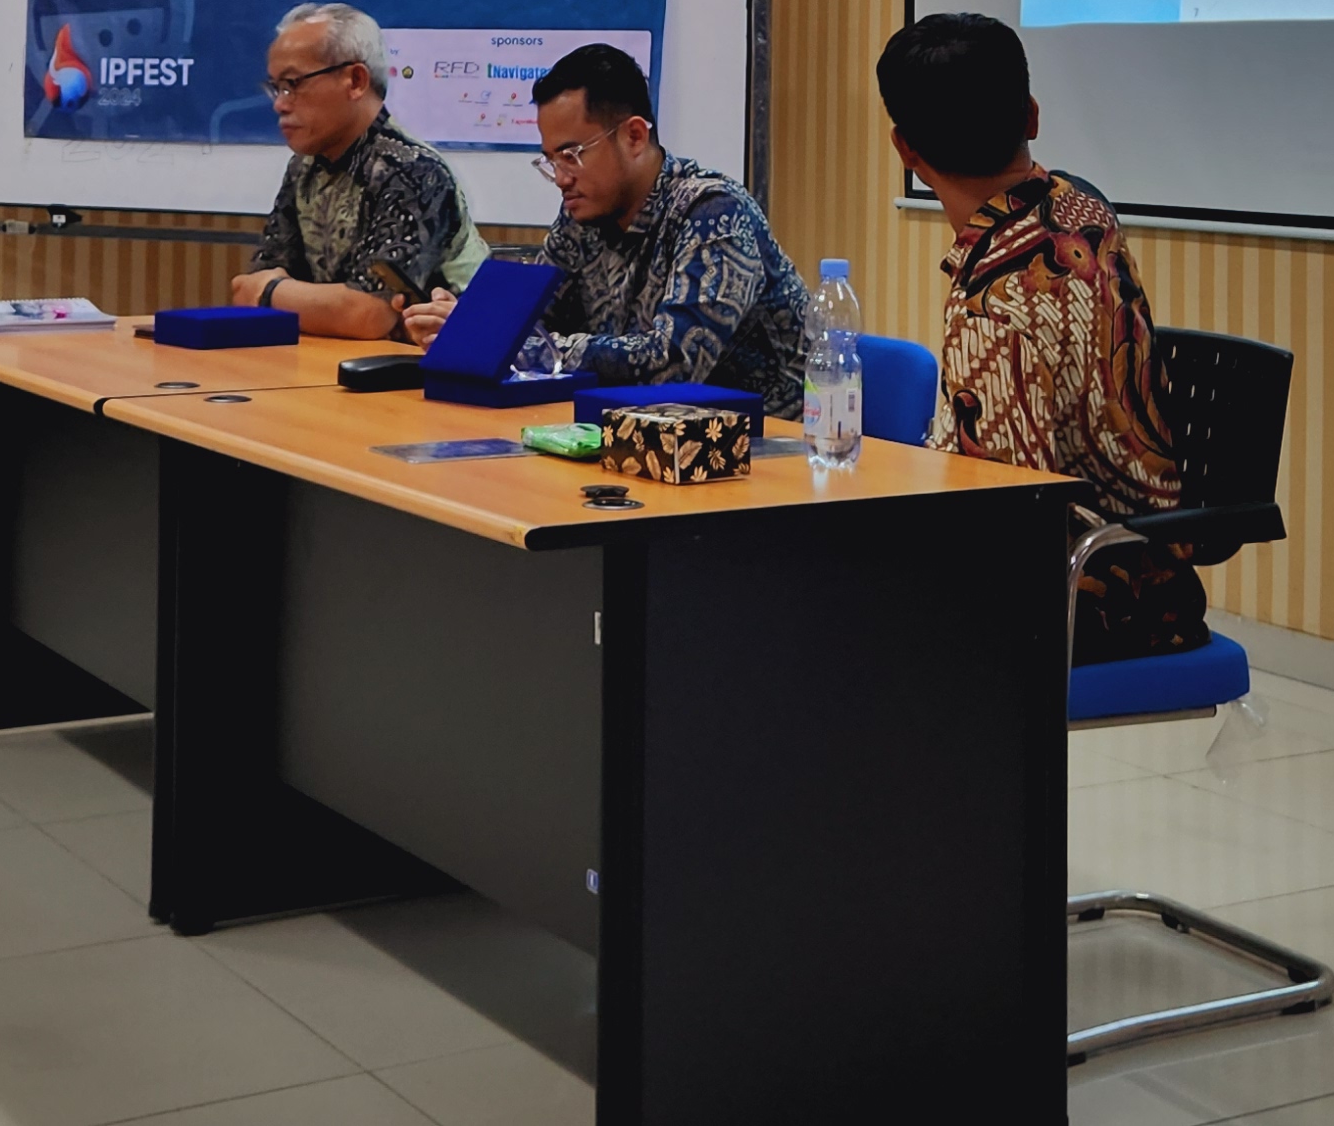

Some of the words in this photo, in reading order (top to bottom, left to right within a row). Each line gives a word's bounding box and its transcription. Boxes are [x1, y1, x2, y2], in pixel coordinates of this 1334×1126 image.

[491, 36, 544, 48] sponsors
[100, 57, 195, 86] IPFEST
[434, 61, 480, 74] RFD
[487, 63, 551, 81] tNavigato
[97, 87, 143, 107] 2024
